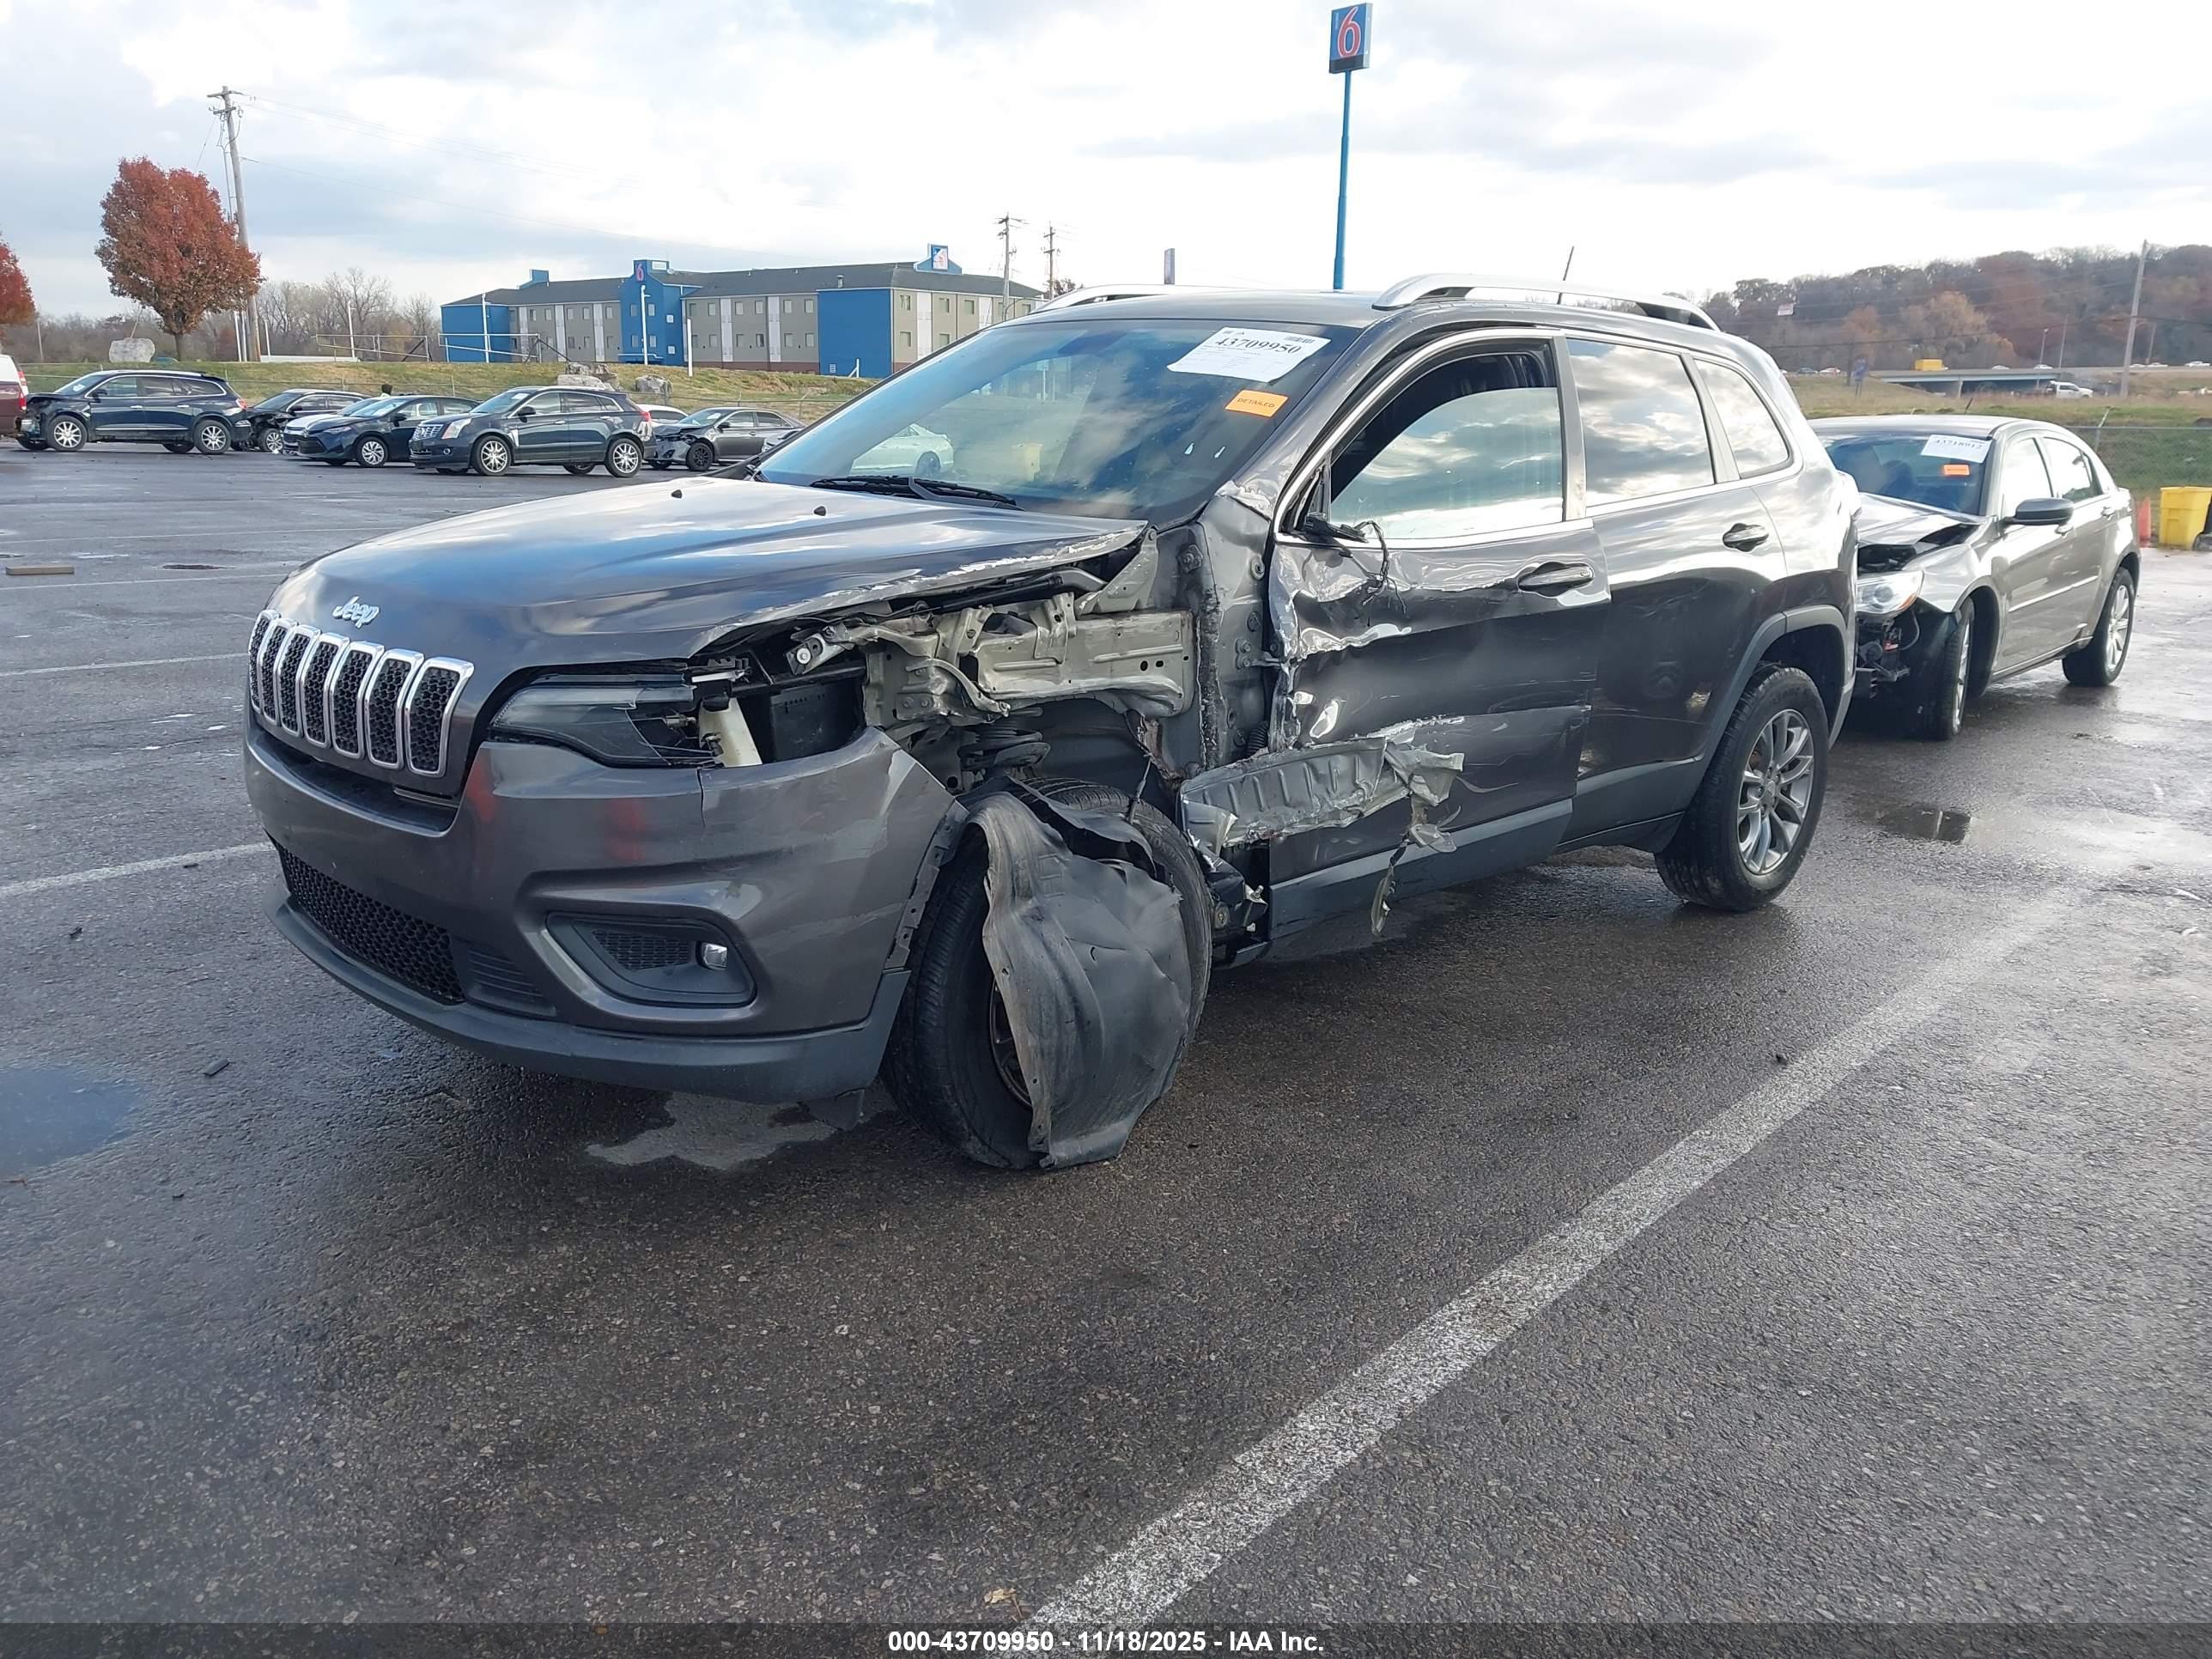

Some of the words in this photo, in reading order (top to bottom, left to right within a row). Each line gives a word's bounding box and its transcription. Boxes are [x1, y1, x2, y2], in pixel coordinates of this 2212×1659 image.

[1338, 6, 1361, 58] 6
[636, 263, 644, 282] 6
[1215, 337, 1302, 354] 43709950
[1237, 398, 1275, 408] DETAILED
[332, 596, 380, 629] Jeep
